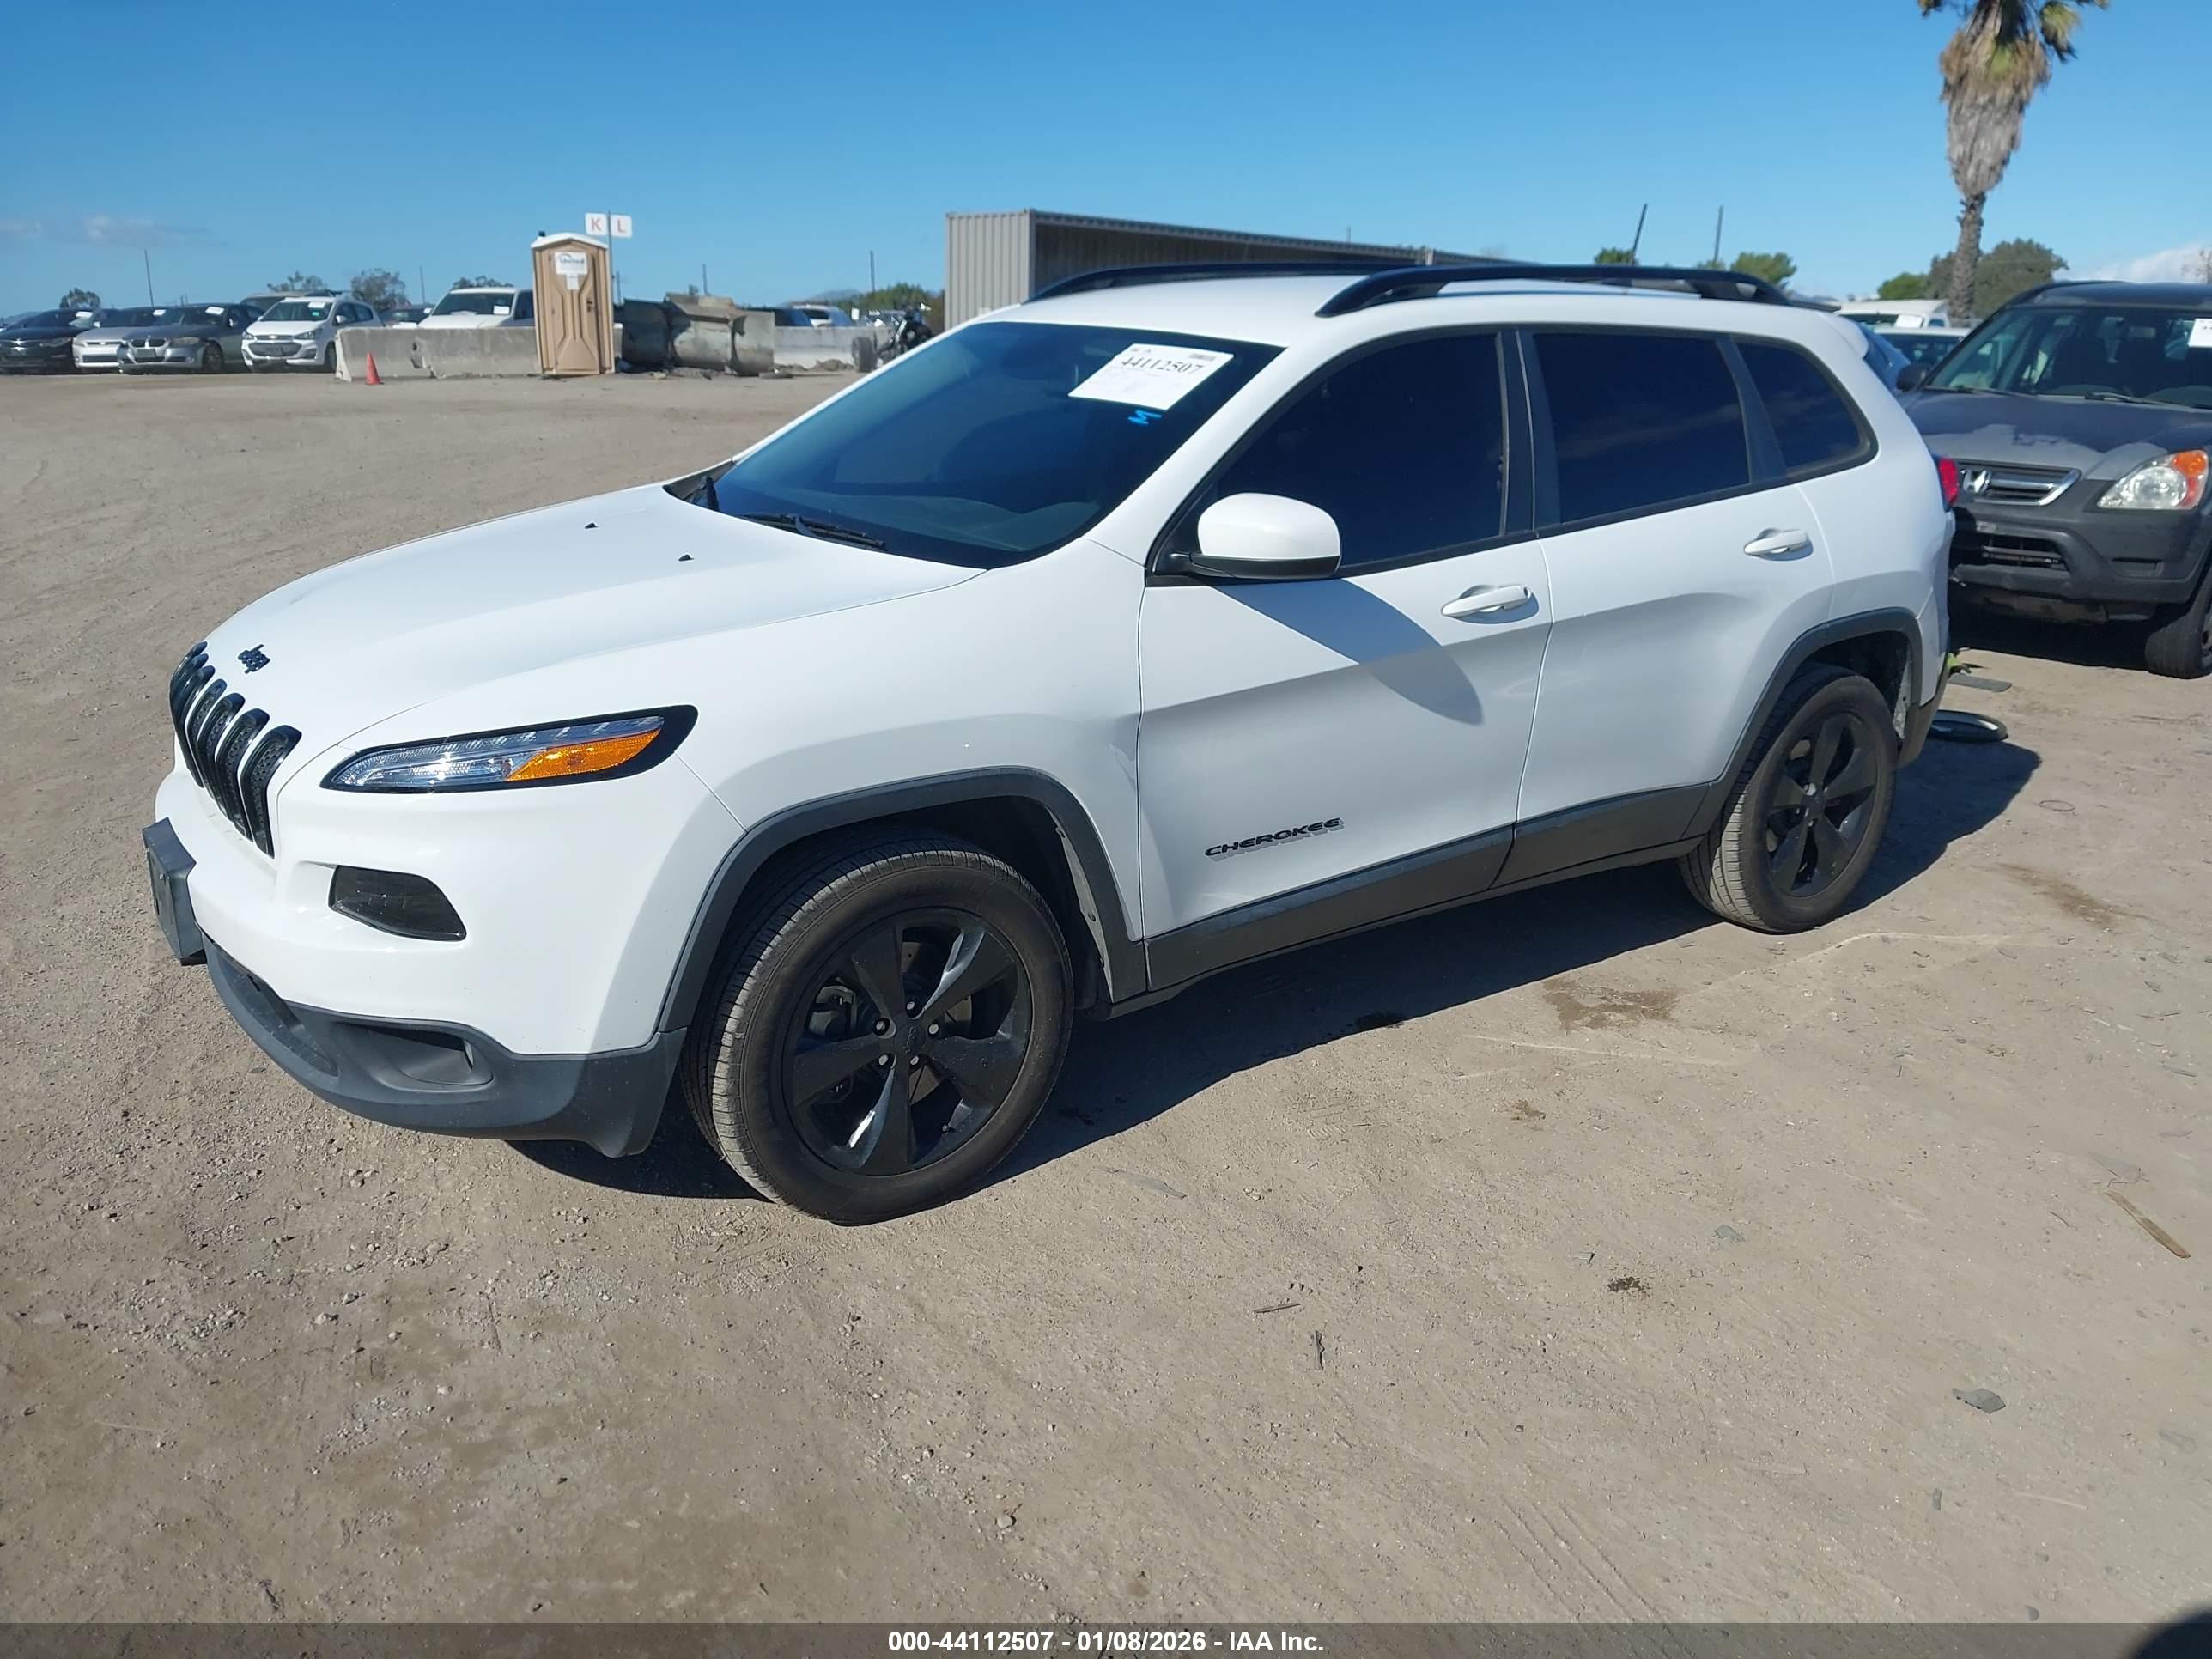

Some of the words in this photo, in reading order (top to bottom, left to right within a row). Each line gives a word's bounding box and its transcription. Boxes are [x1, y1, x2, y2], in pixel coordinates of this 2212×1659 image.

[591, 218, 602, 232] K
[617, 220, 626, 233] L
[1205, 817, 1341, 857] CHEROKEE
